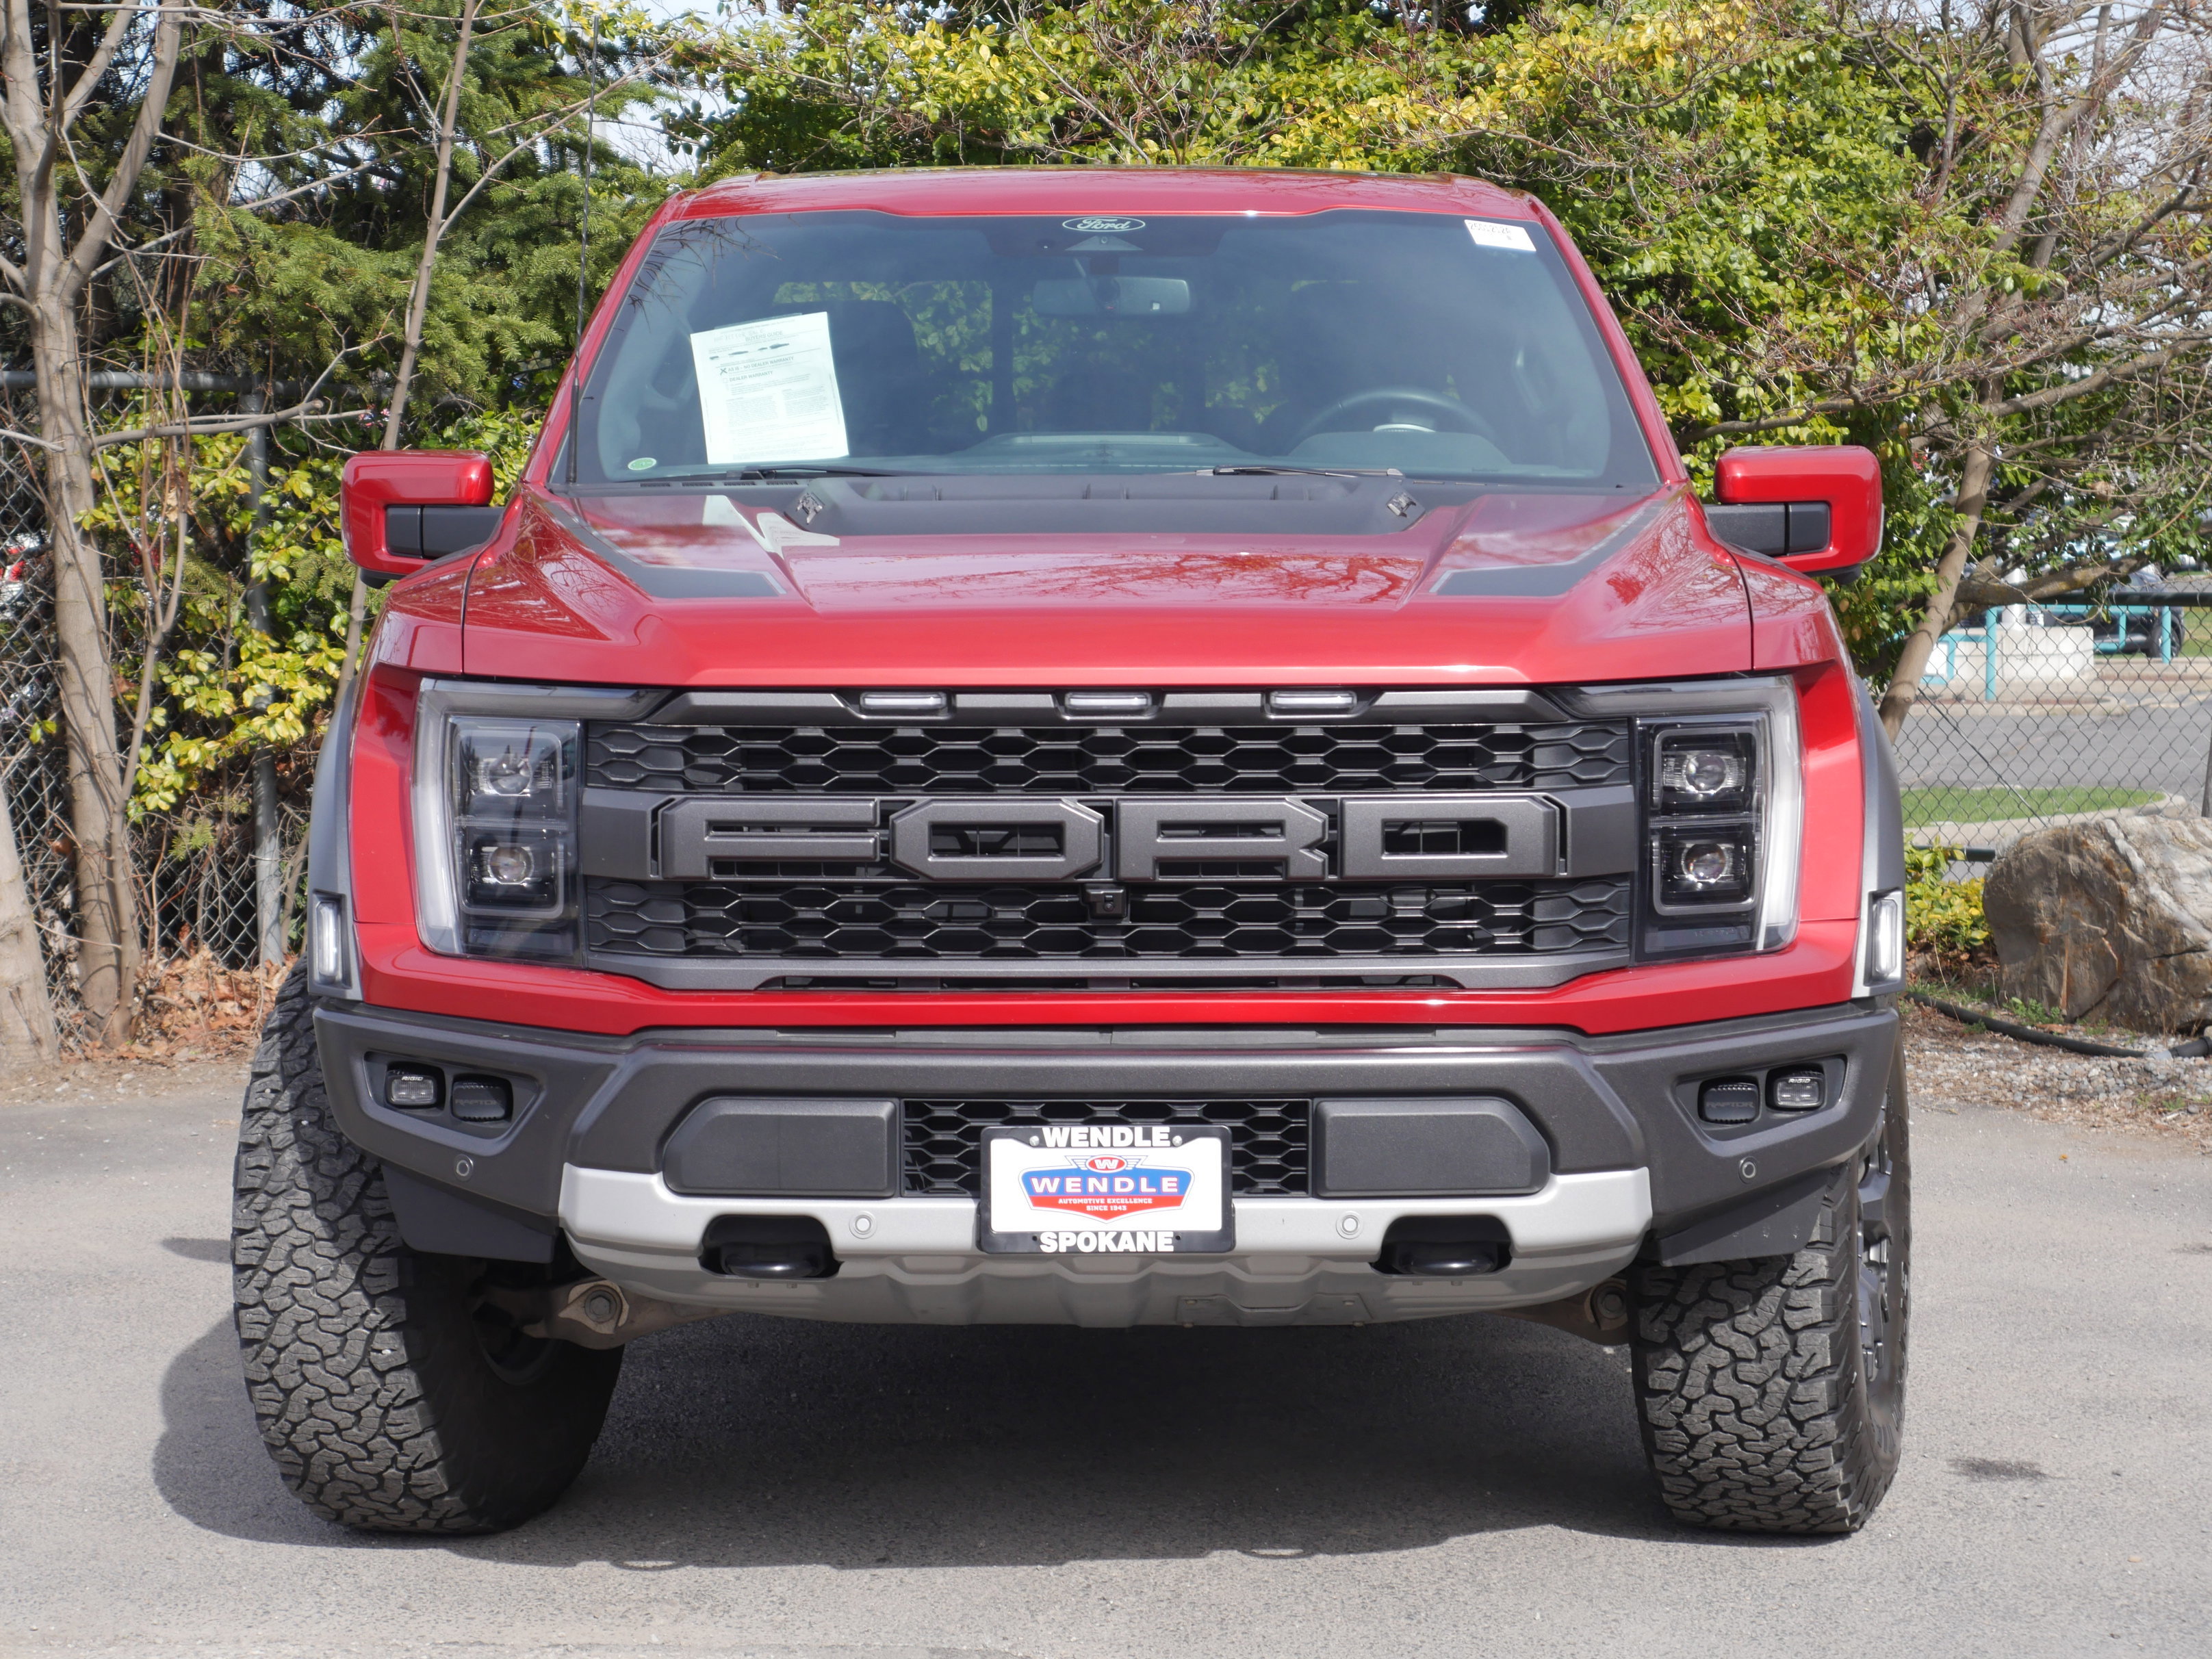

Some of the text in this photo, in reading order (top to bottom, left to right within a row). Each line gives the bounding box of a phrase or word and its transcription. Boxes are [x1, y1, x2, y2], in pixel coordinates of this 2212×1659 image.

[1077, 218, 1131, 229] Ford
[662, 797, 1556, 879] FORD
[1042, 1127, 1171, 1148] WENDLE
[1031, 1177, 1179, 1193] WENDLE
[1040, 1231, 1174, 1252] SPOKANE
